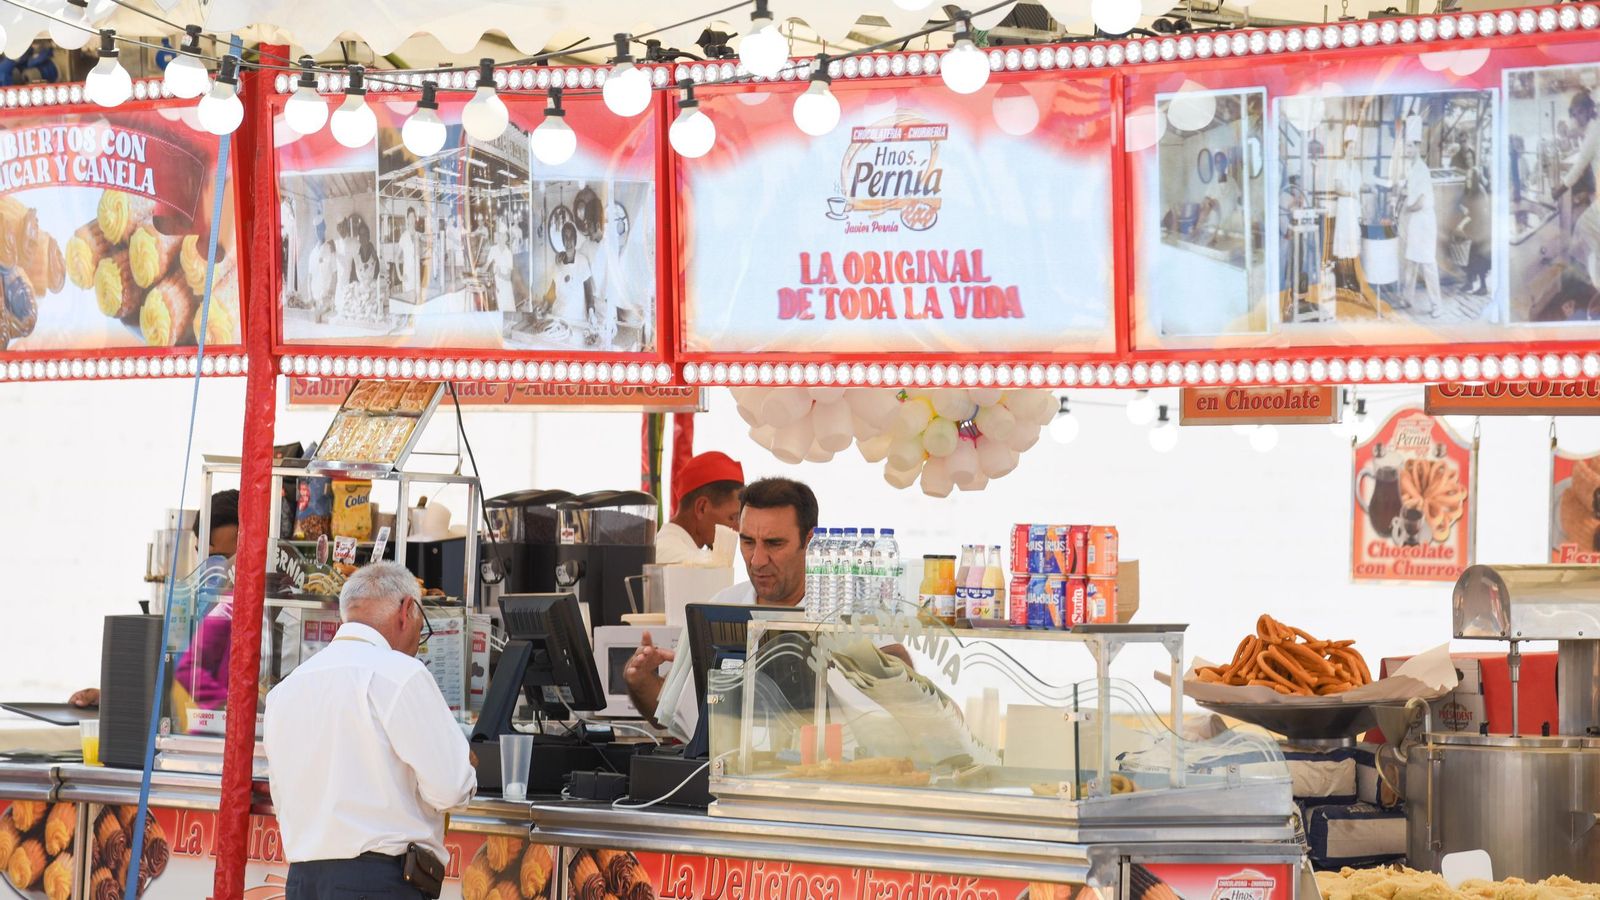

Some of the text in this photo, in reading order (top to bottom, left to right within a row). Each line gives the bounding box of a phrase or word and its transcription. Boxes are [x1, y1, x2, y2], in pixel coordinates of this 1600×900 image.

[102, 129, 147, 163] CON
[874, 146, 917, 166] Hnos.
[54, 155, 69, 182] Y
[73, 156, 157, 196] CANELA
[850, 159, 943, 198] Pernía
[844, 221, 869, 234] Javier
[799, 249, 992, 284] LA ORIGINAL
[777, 284, 1025, 320] DE TODA LA VIDA
[1196, 388, 1320, 411] en Chocolate
[1367, 540, 1455, 561] Chocolate
[1355, 560, 1463, 577] con Churros
[172, 810, 204, 856] La
[659, 853, 694, 898] La
[702, 856, 841, 900] Deliciosa
